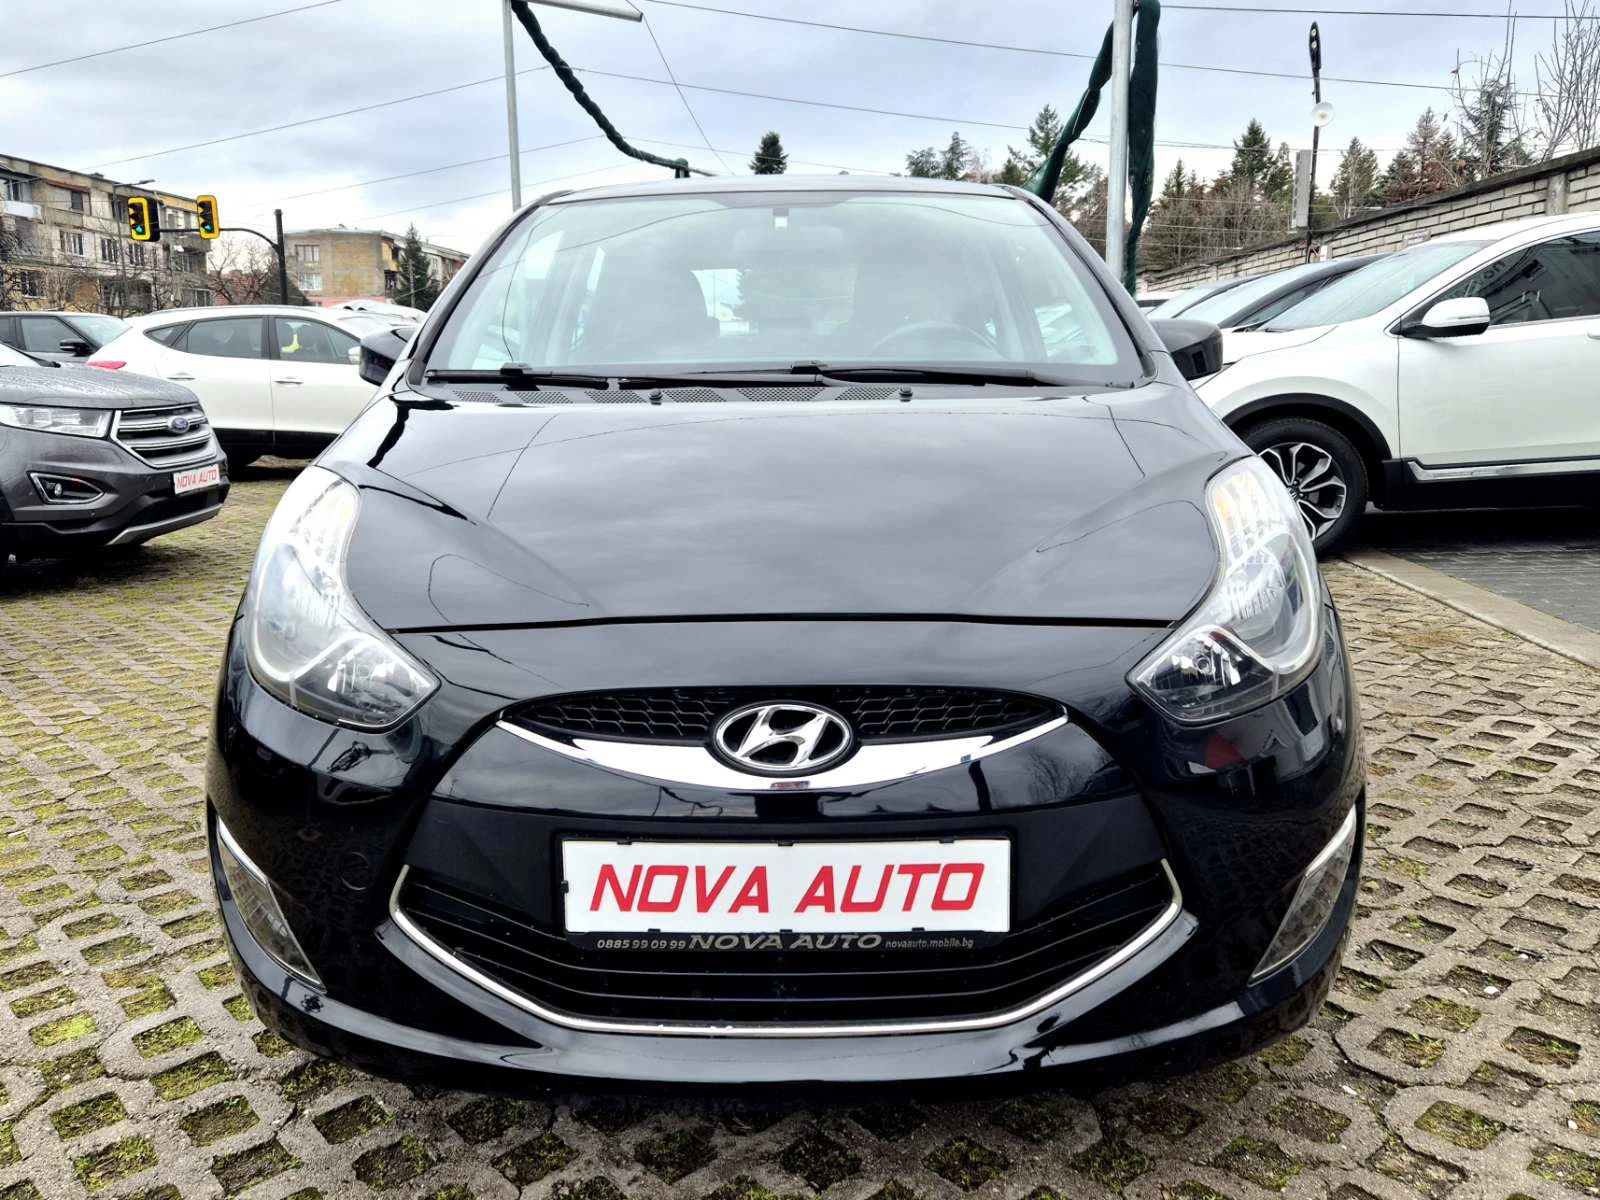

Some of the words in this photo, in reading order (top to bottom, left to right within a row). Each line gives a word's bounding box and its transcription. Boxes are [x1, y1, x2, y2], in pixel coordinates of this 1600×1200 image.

[176, 473, 197, 489] NOVA
[198, 469, 217, 483] AUTO
[590, 864, 769, 913] NOVA
[794, 863, 985, 913] AUTO
[597, 939, 630, 949] 0885
[688, 934, 784, 949] NOVA
[789, 934, 882, 949] AUTO
